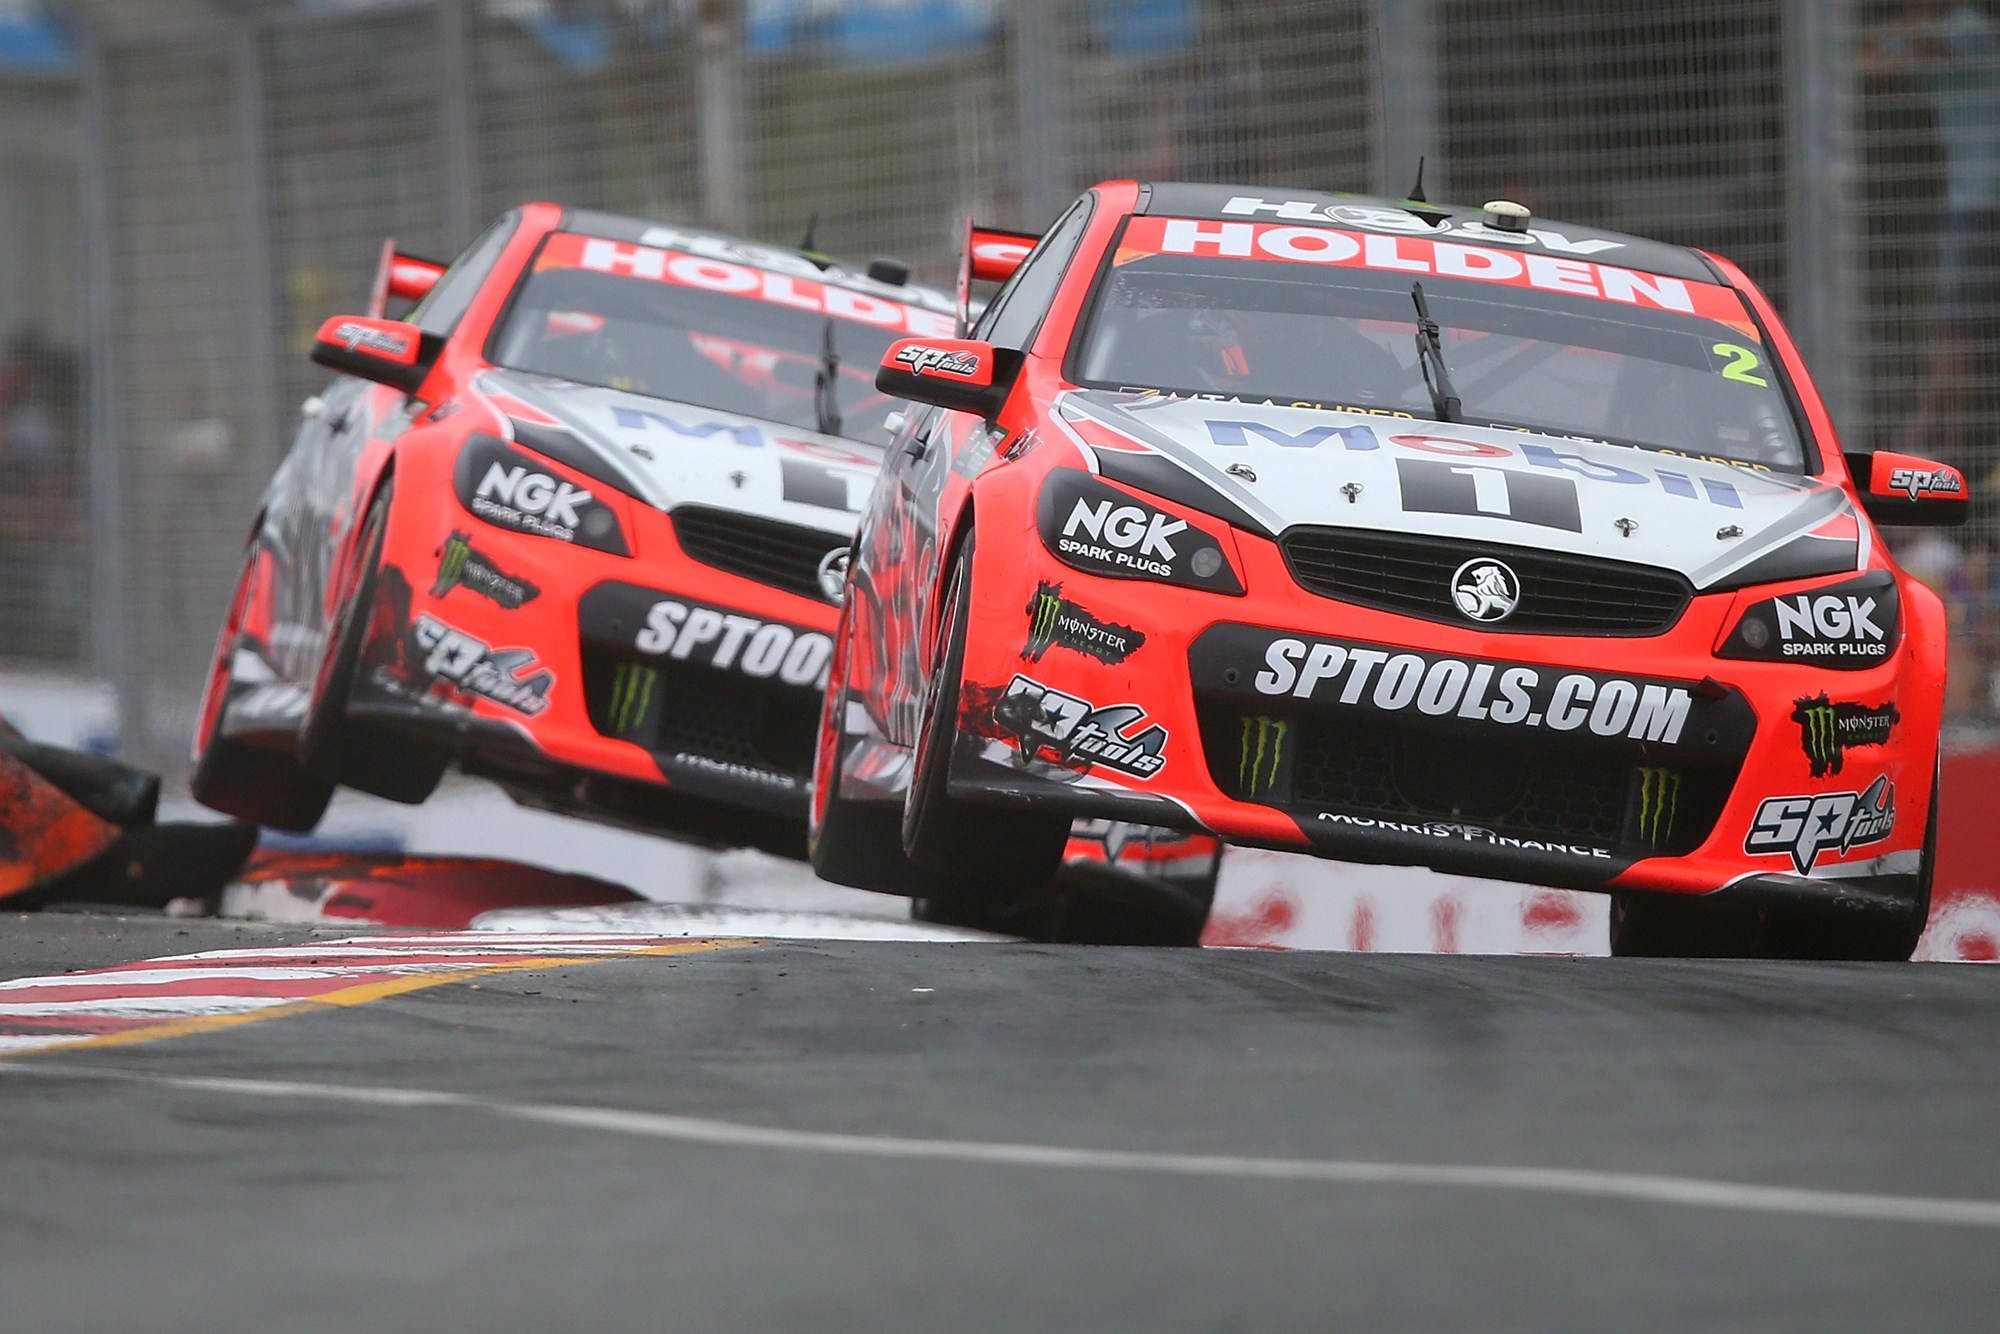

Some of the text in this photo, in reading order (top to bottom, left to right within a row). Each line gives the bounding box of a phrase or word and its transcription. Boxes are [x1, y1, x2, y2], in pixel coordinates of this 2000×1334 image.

[579, 238, 957, 338] HOLDE
[1162, 219, 1695, 313] HOLDEN
[1713, 343, 1768, 387] 2
[1202, 418, 1744, 509] Mobil
[1449, 466, 1512, 516] 1
[476, 460, 593, 529] NGK
[1058, 538, 1173, 577] SPARK PLUGS
[1062, 496, 1188, 562] NGK
[635, 600, 835, 690] SPTOO
[1058, 614, 1127, 652] MONSTER
[1773, 595, 1885, 641] NGK
[1782, 643, 1887, 656] SPARK PLUGS
[1254, 638, 1693, 744] SPTOOLS.COM
[1838, 714, 1891, 732] MONSTER
